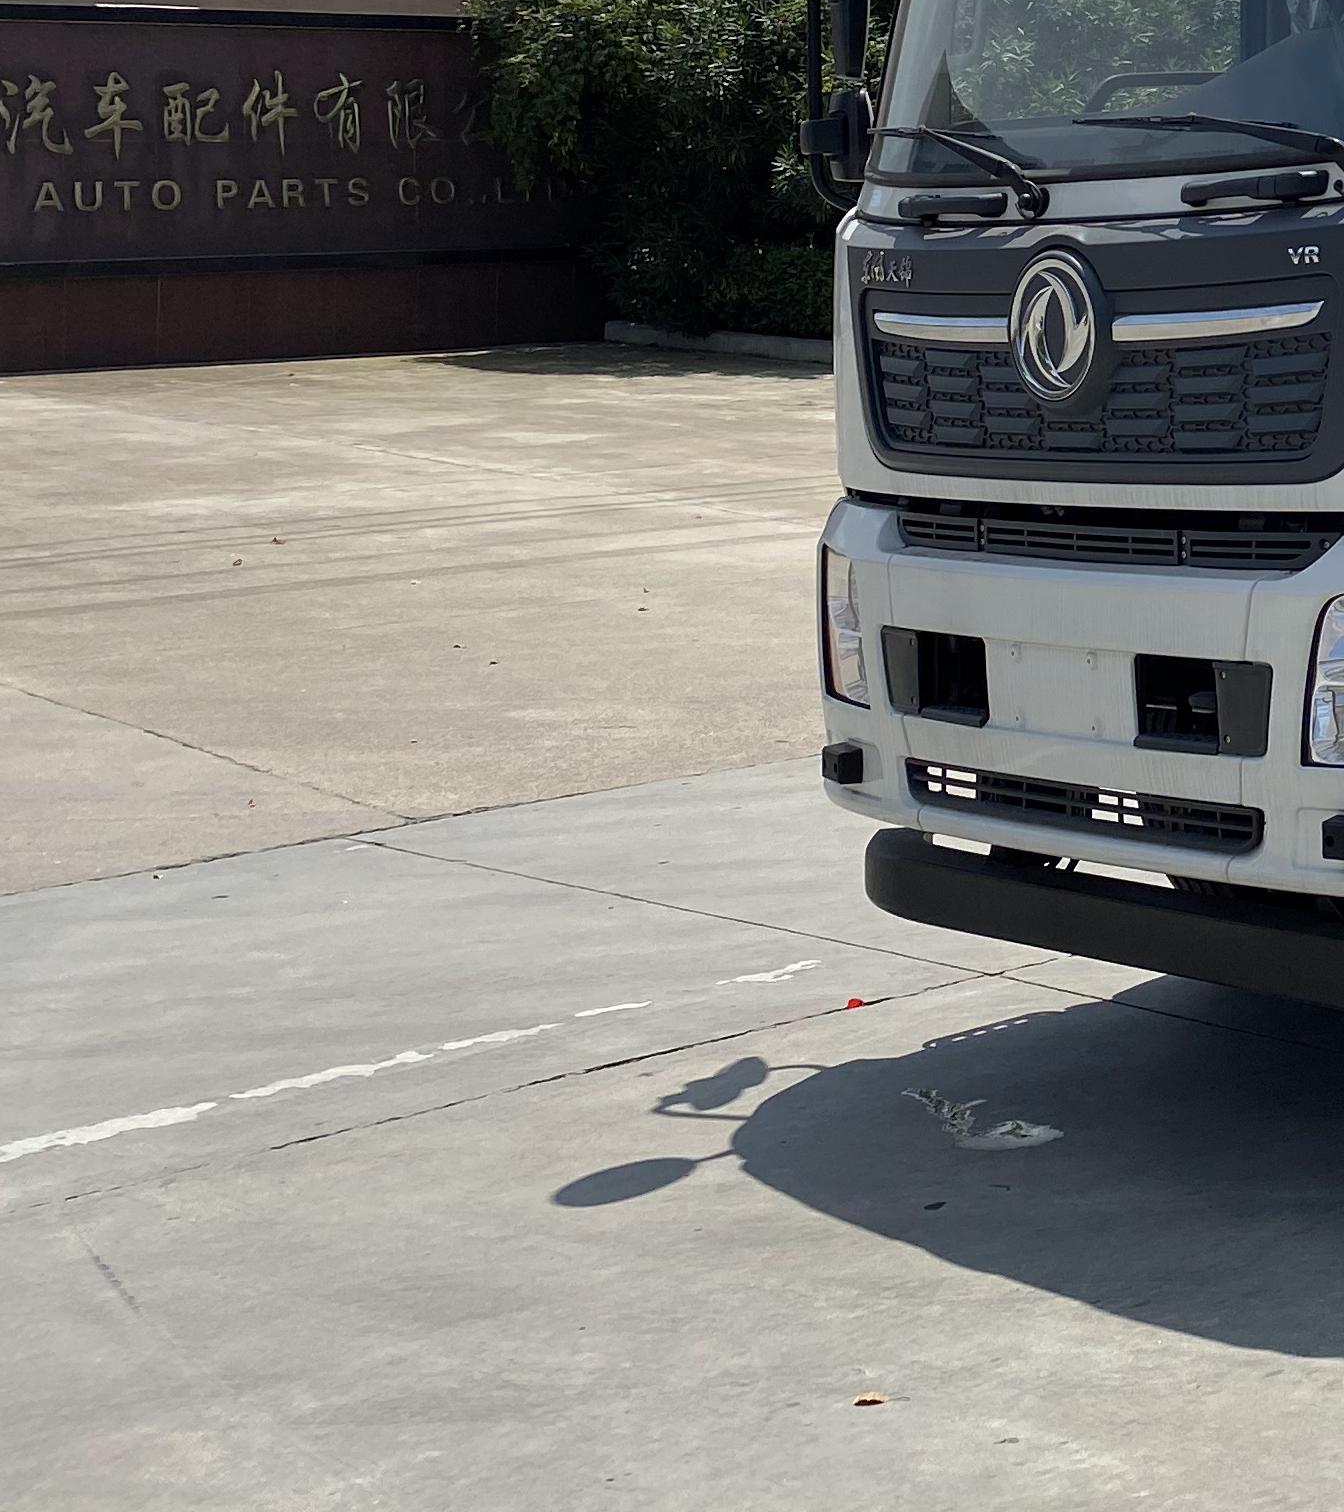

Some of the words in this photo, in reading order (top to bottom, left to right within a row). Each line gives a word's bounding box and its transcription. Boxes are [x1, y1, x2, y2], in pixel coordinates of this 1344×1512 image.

[34, 179, 182, 211] AUTO
[217, 178, 370, 210] PARTS
[1287, 245, 1320, 265] VR
